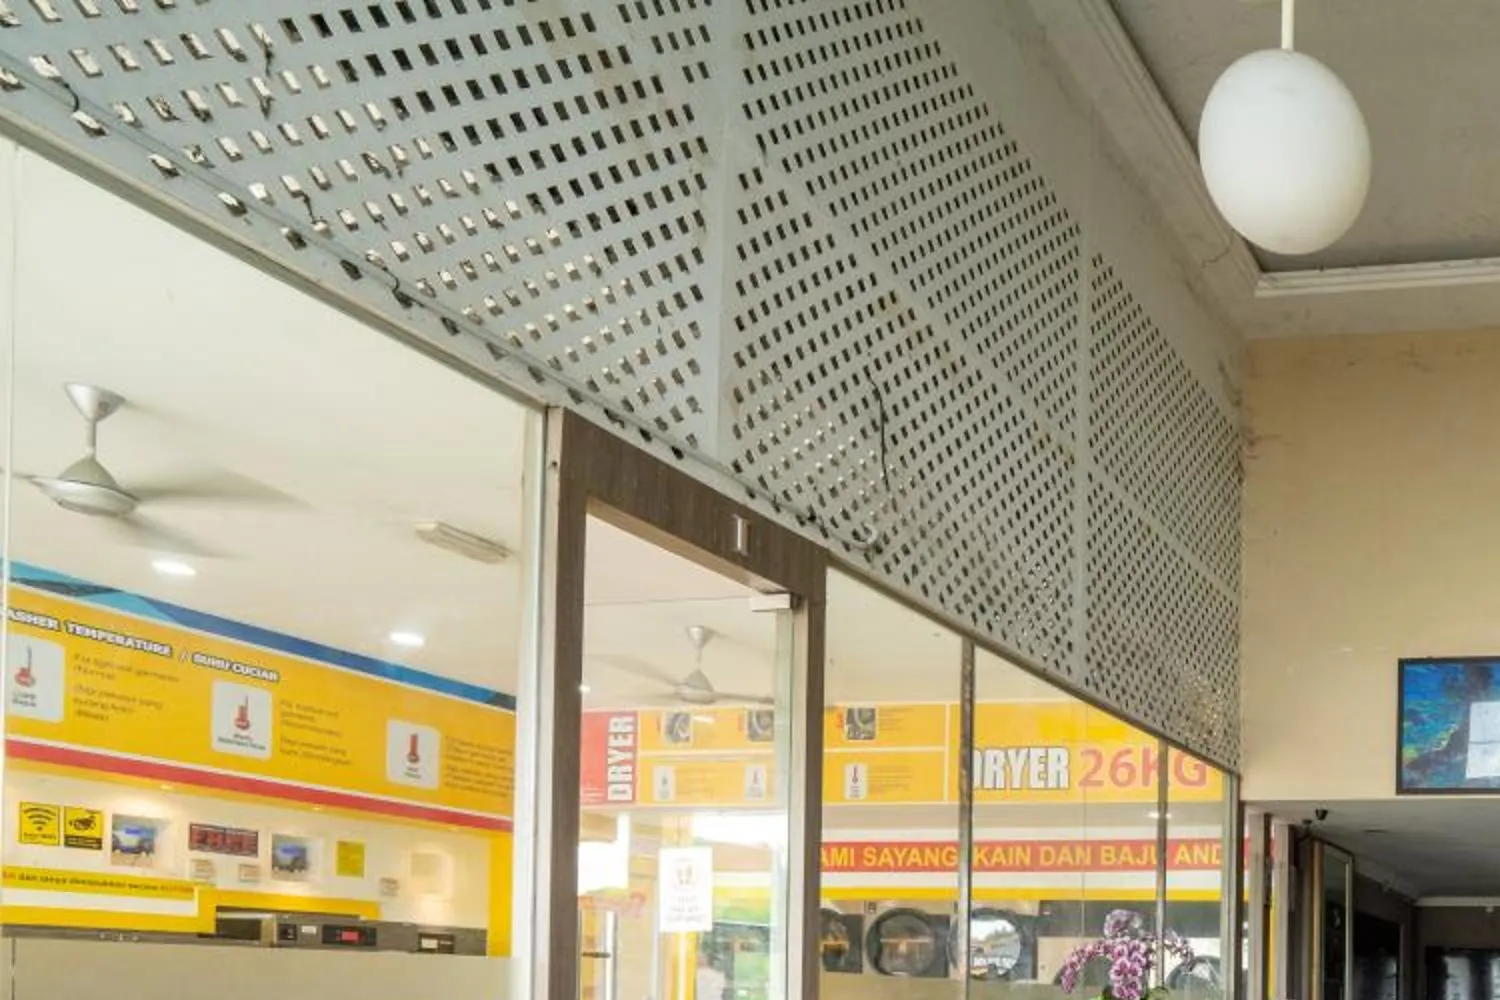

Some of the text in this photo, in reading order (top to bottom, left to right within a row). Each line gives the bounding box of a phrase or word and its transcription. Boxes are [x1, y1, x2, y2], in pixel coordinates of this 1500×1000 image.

[66, 621, 171, 656] TEMPERATURE
[607, 716, 635, 801] DRYER
[1077, 746, 1208, 788] 26KG
[862, 845, 958, 868] SAYANG
[974, 846, 1031, 866] KAIN
[1039, 846, 1092, 866] DAN
